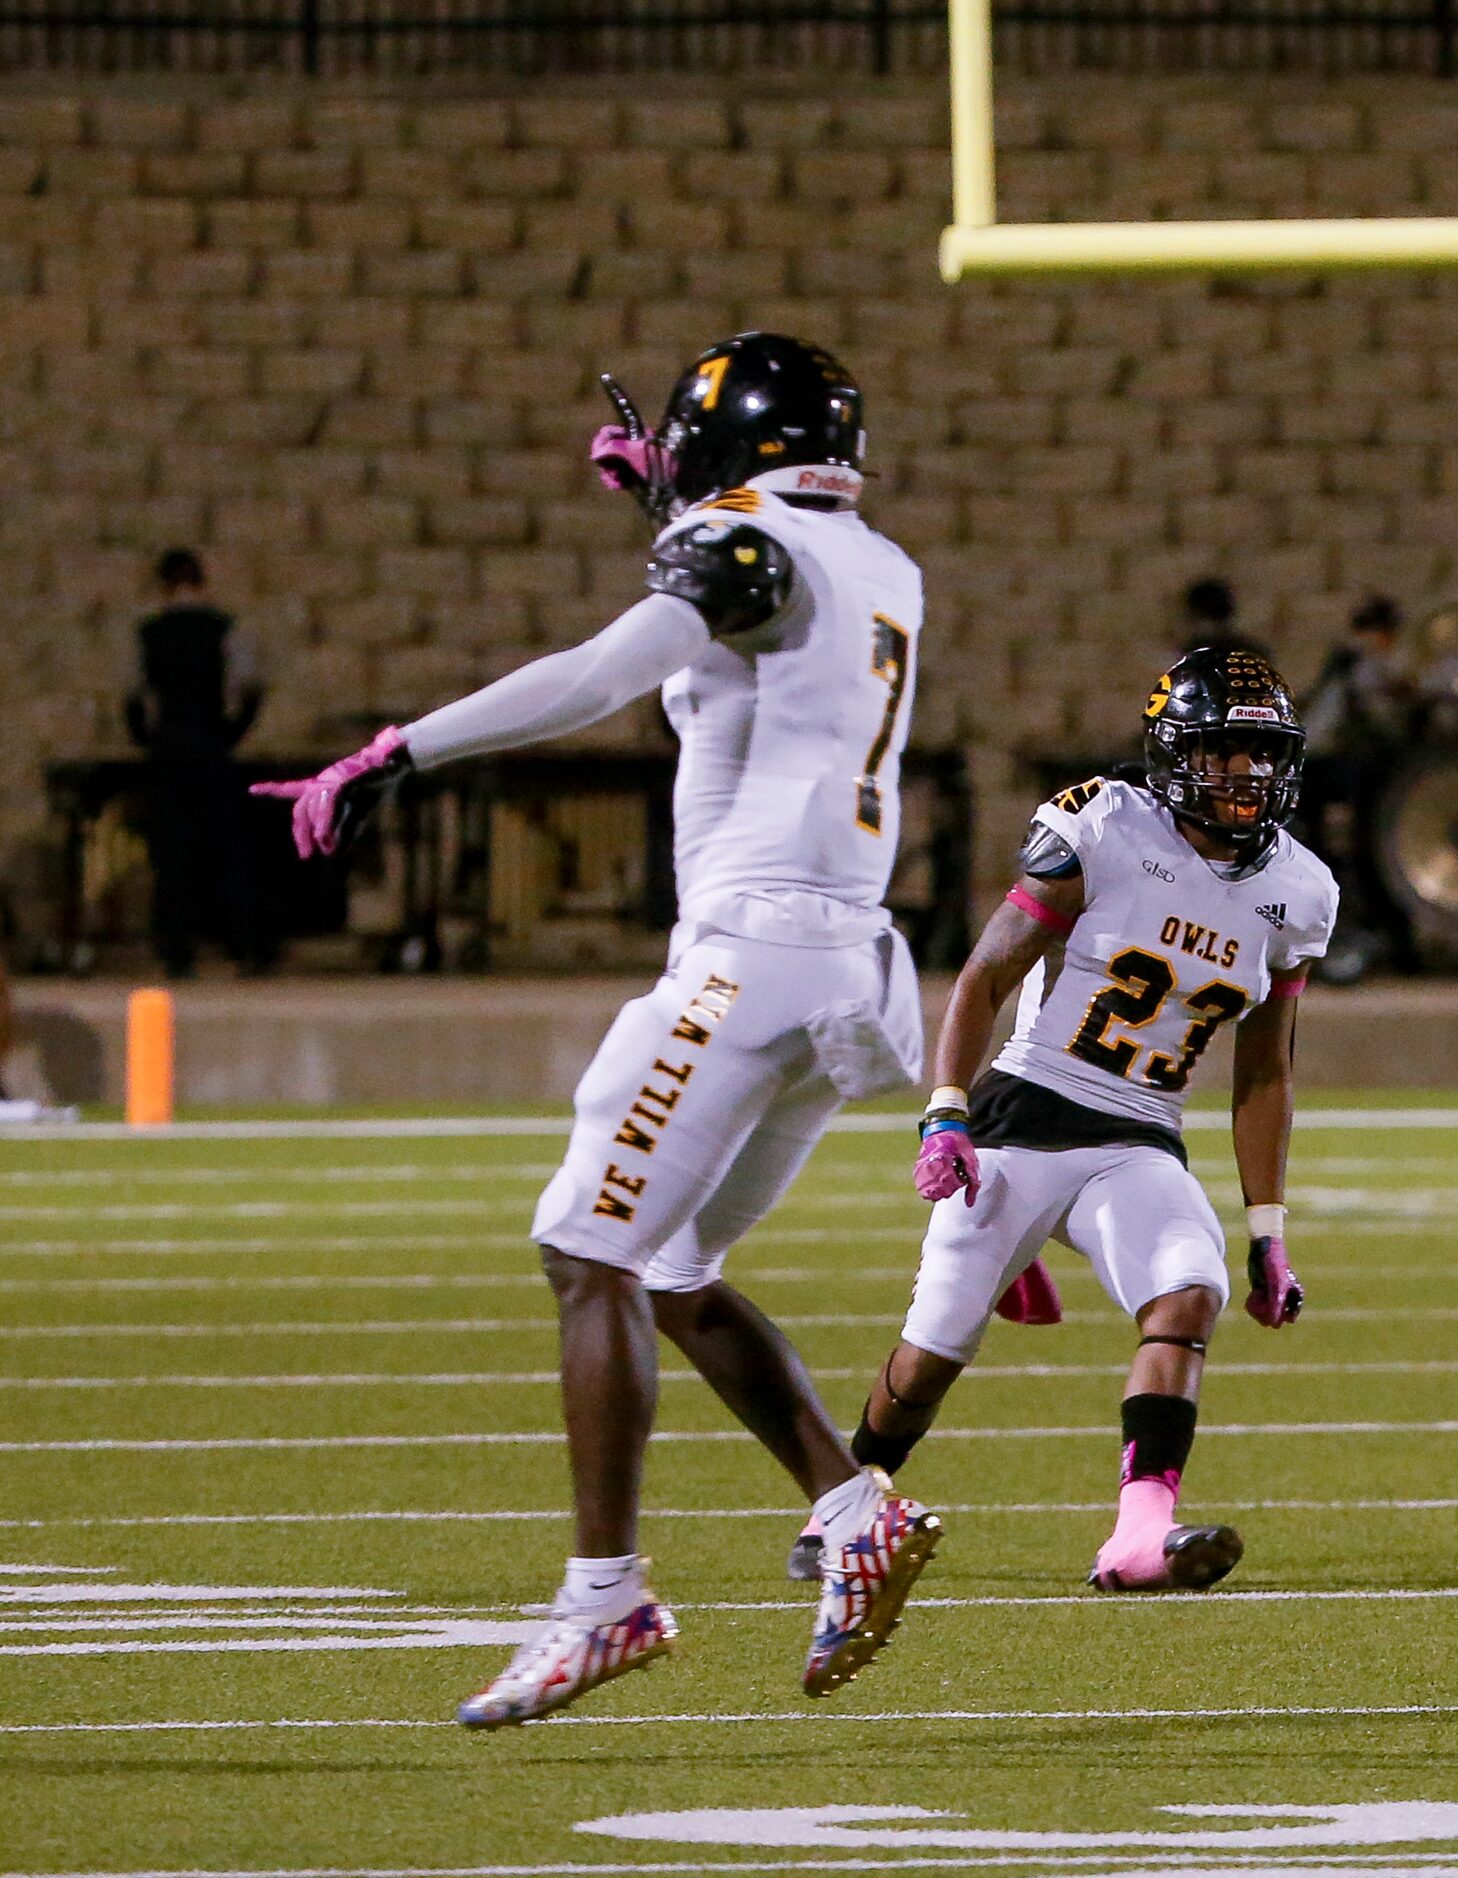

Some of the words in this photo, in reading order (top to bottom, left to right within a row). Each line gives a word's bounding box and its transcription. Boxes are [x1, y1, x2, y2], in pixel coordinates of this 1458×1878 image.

[699, 356, 732, 410] 7
[852, 611, 909, 839] 7
[1236, 709, 1274, 719] Riddell
[1142, 859, 1176, 883] GISD
[1159, 915, 1240, 971] OWLS
[670, 972, 743, 1048] WIN
[1063, 945, 1250, 1093] 23
[612, 1057, 697, 1156] WILL
[592, 1162, 648, 1224] WE
